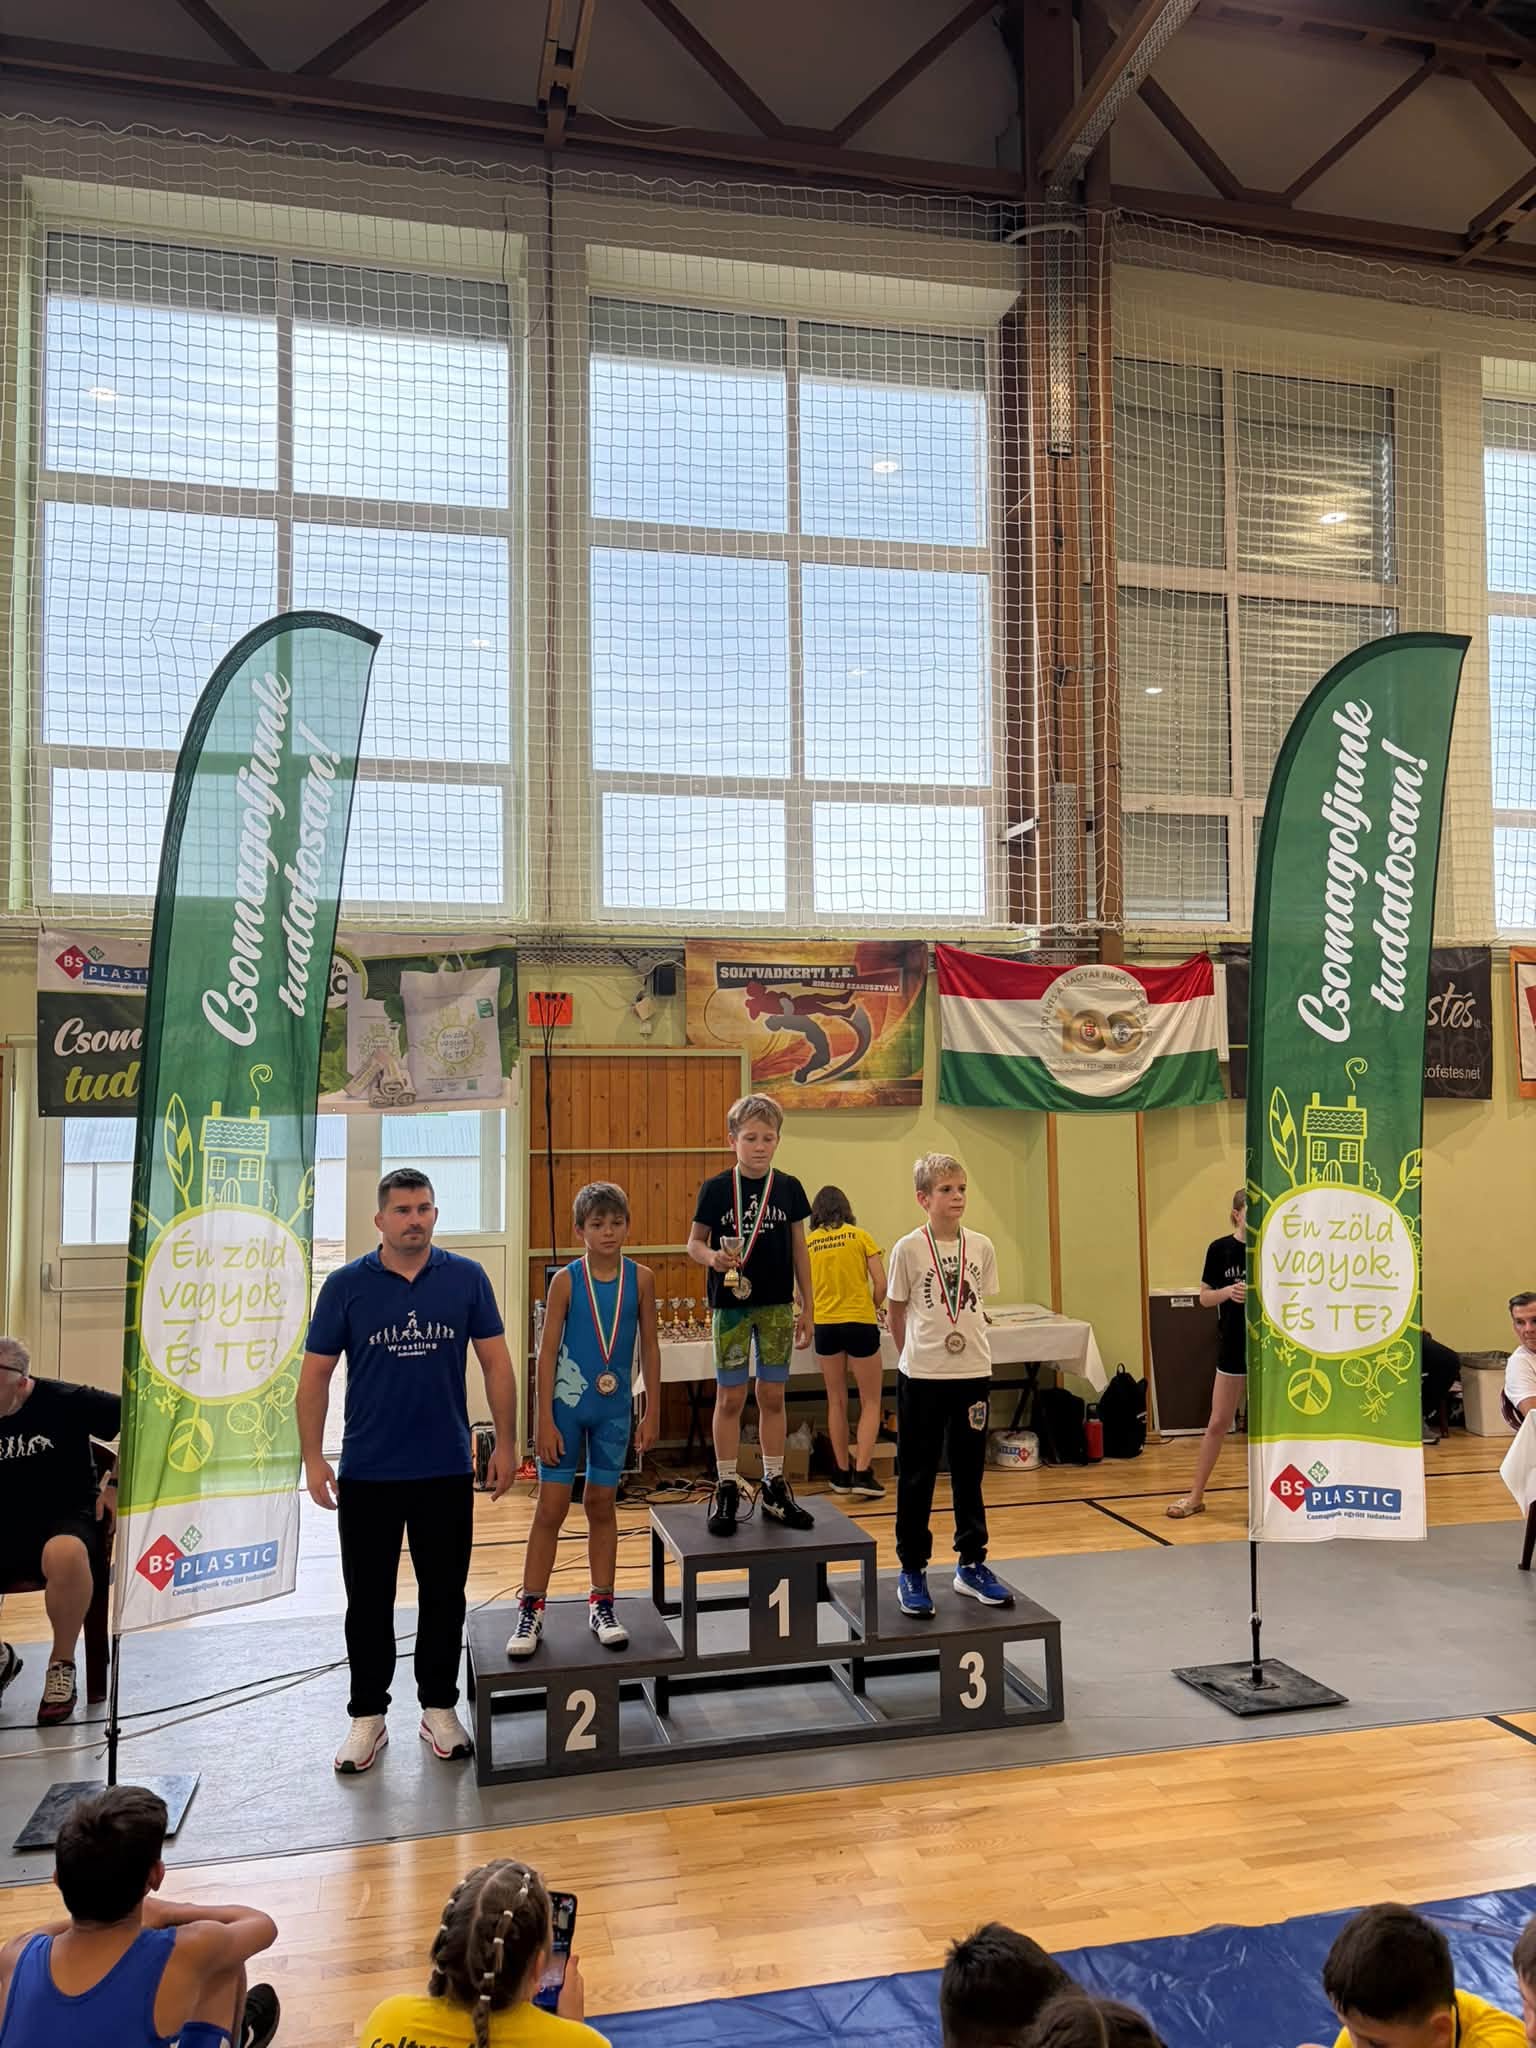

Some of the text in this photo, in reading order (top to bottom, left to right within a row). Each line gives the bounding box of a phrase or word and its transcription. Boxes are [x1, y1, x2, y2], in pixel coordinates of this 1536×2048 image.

[202, 671, 290, 1046] Csomagoljunk
[278, 721, 342, 1017] tudatosan!
[1298, 698, 1373, 1044] Csomagoljunk
[1370, 738, 1428, 1012] tudatosan!
[64, 955, 84, 968] BS
[719, 966, 854, 980] SOLTVADKERTI T.E.
[1062, 971, 1100, 988] MAGYAR
[1281, 1203, 1394, 1243] Én zöld
[170, 1229, 288, 1271] Én zöld
[1271, 1246, 1400, 1293] vagyok.
[159, 1272, 288, 1328] vagyok.
[1281, 1291, 1393, 1335] És TE?
[165, 1328, 279, 1377] És TE?
[387, 1341, 438, 1353] Wrestling
[1279, 1480, 1394, 1507] BS PLASTIC
[149, 1547, 273, 1579] BS PLASTIC
[768, 1578, 790, 1638] 1
[958, 1651, 988, 1711] 3
[564, 1688, 598, 1753] 2
